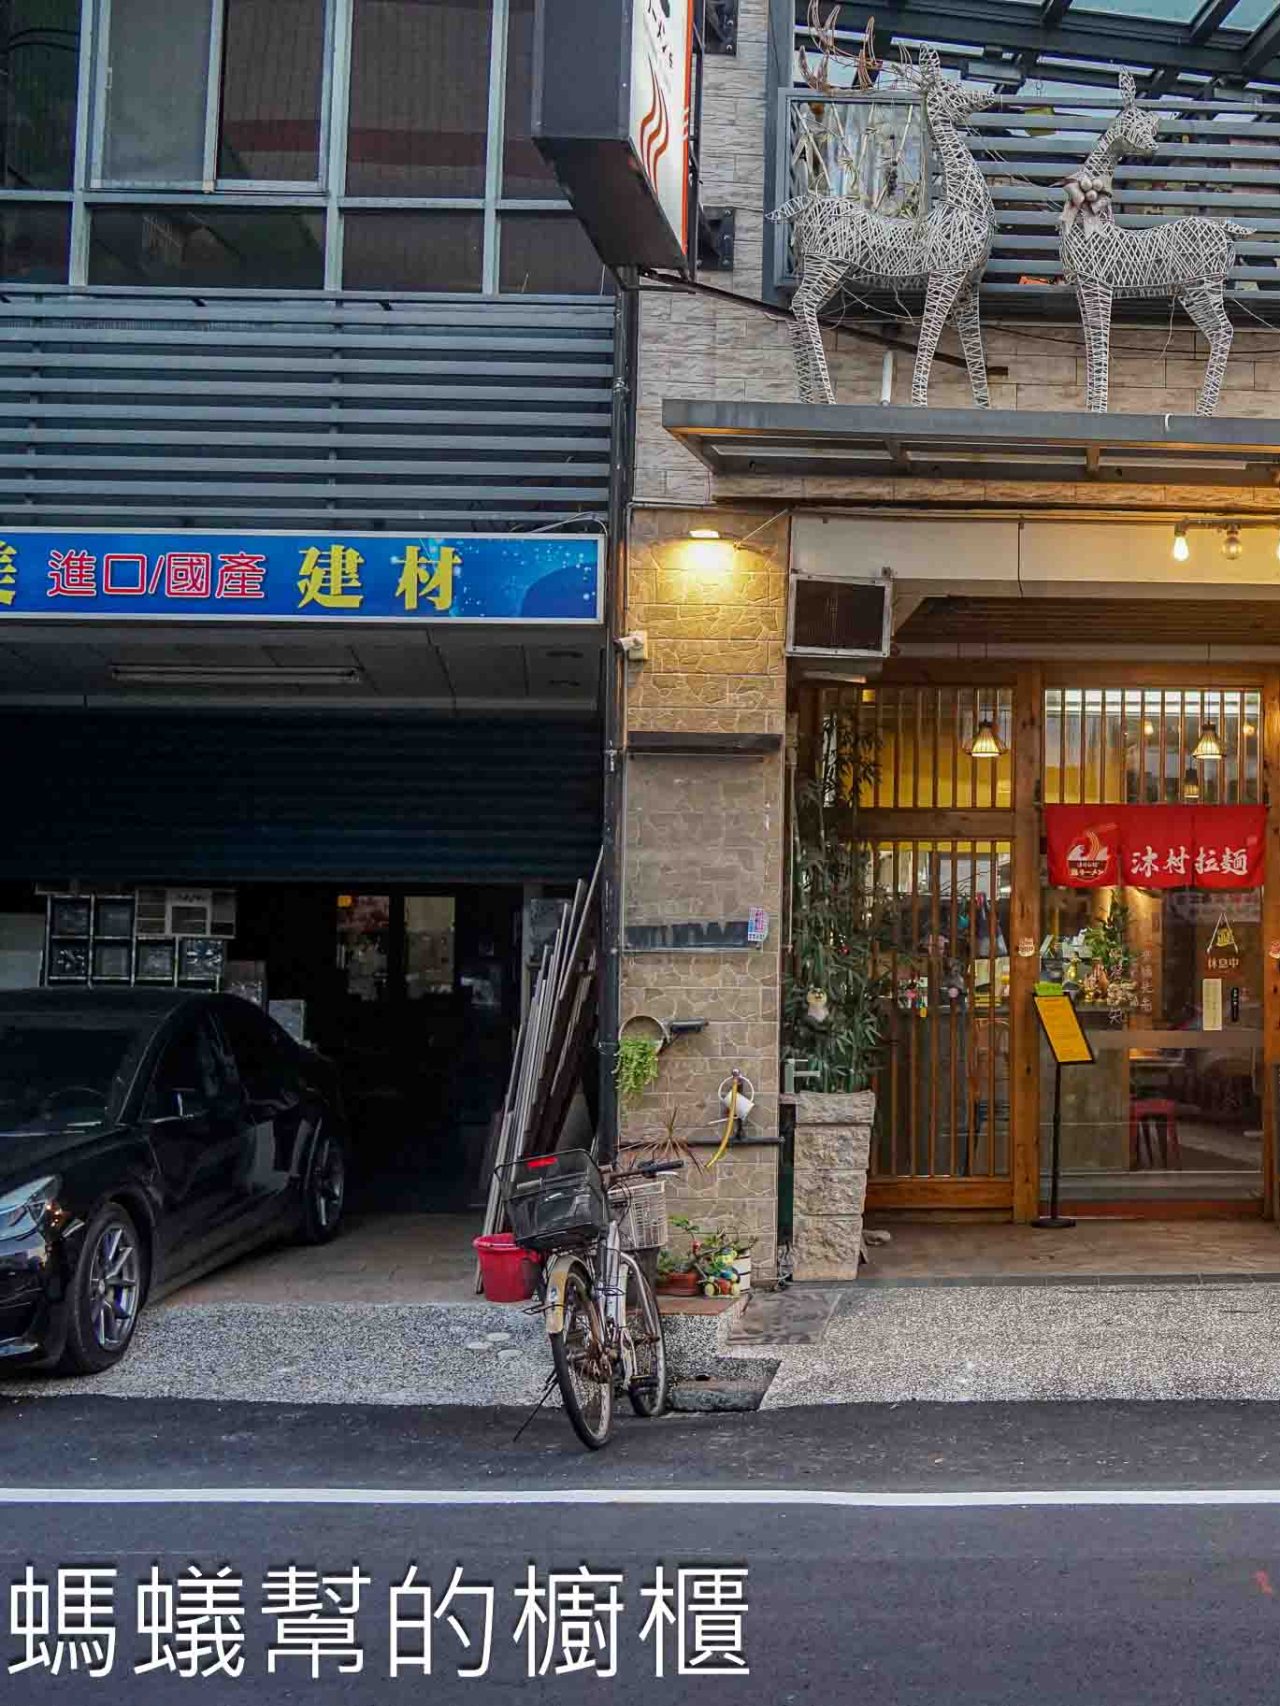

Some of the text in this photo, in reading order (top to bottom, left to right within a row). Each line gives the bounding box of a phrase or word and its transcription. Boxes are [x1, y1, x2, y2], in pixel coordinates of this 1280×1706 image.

[47, 550, 266, 599] 進口/國產
[296, 544, 462, 610] 建材
